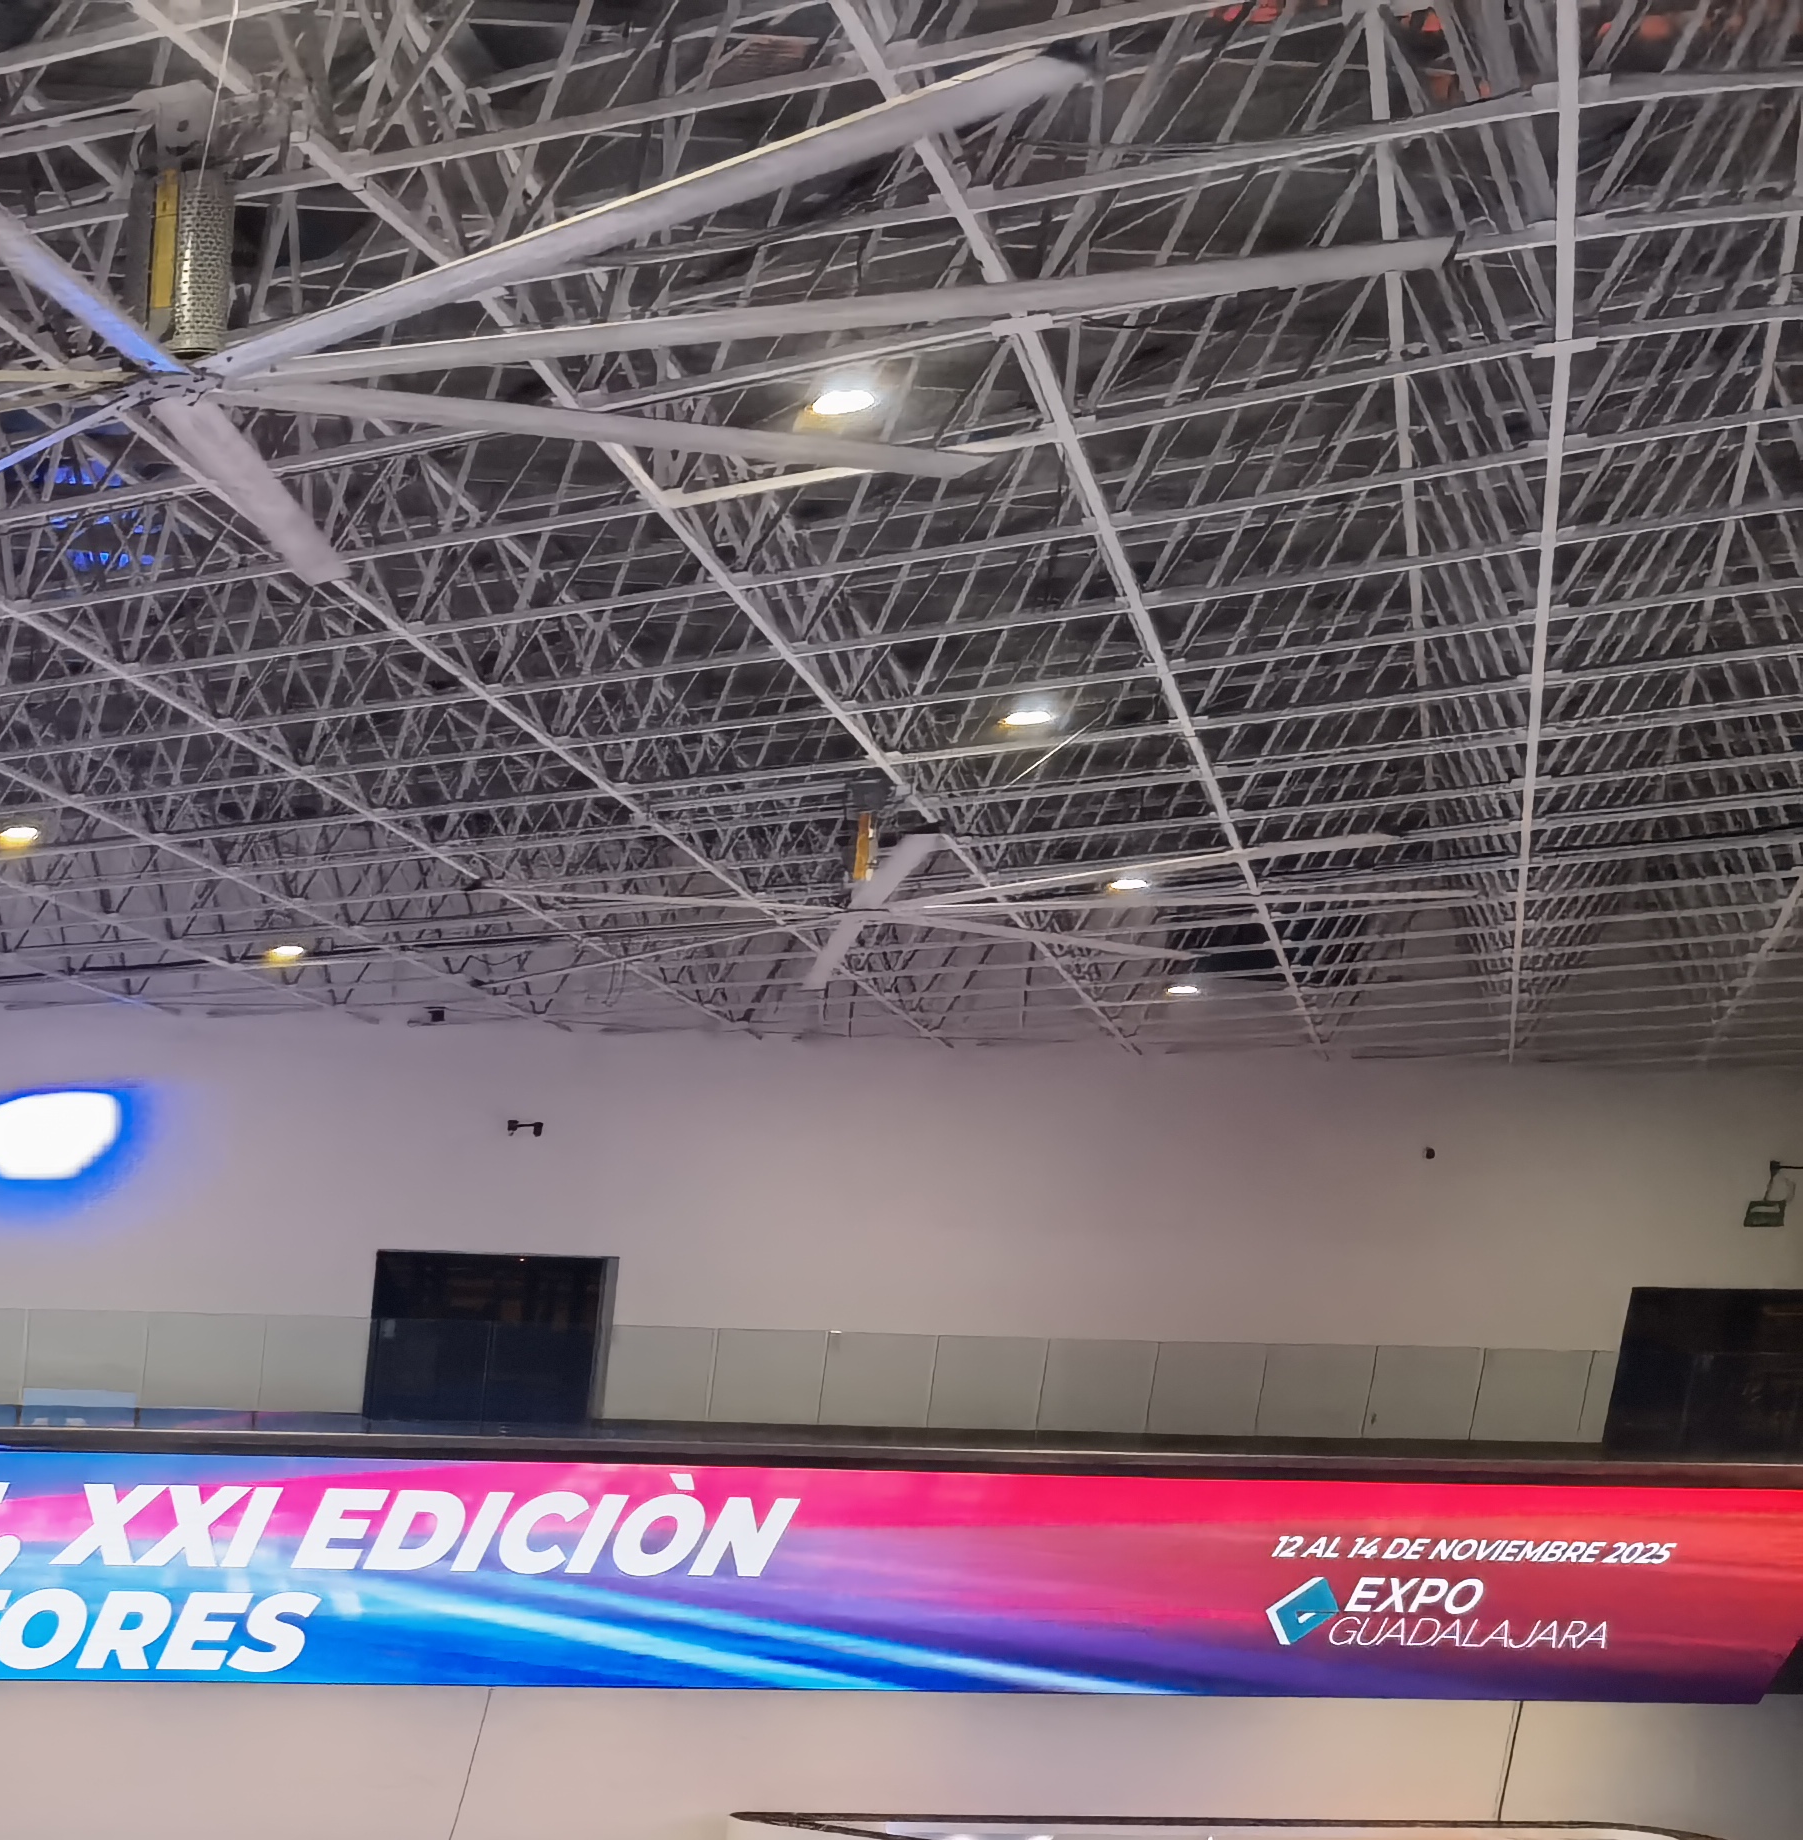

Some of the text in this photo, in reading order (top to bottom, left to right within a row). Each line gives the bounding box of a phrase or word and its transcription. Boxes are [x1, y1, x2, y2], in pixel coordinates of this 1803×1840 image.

[47, 1482, 281, 1571] XXI
[1271, 1535, 1677, 1566] 12 AL 14 DE NOVIEMBRE 2025
[1343, 1576, 1485, 1615] EXPO
[1328, 1616, 1608, 1651] GUADALAJARA
